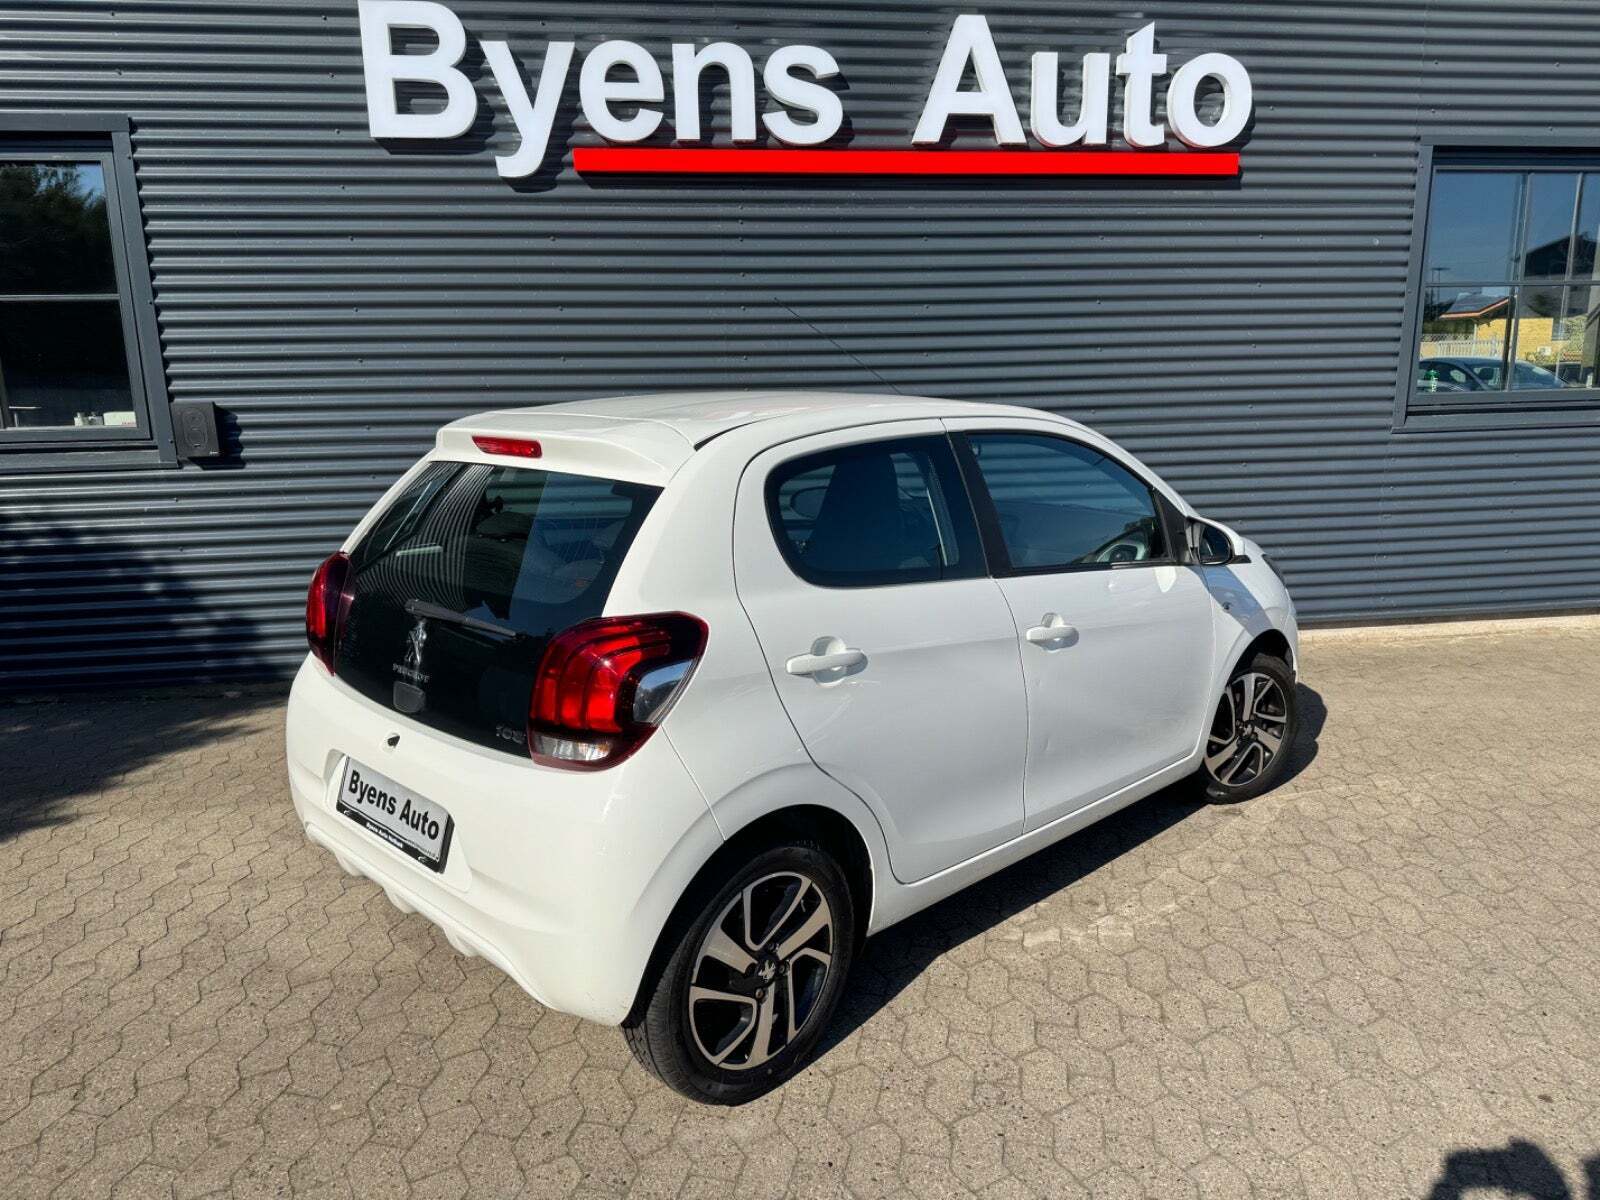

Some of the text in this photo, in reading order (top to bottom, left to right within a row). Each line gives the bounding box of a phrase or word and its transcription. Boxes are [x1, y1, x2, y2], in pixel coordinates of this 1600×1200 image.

[358, 0, 1253, 178] Byens Auto
[348, 769, 397, 816] Byens
[399, 798, 440, 841] Auto
